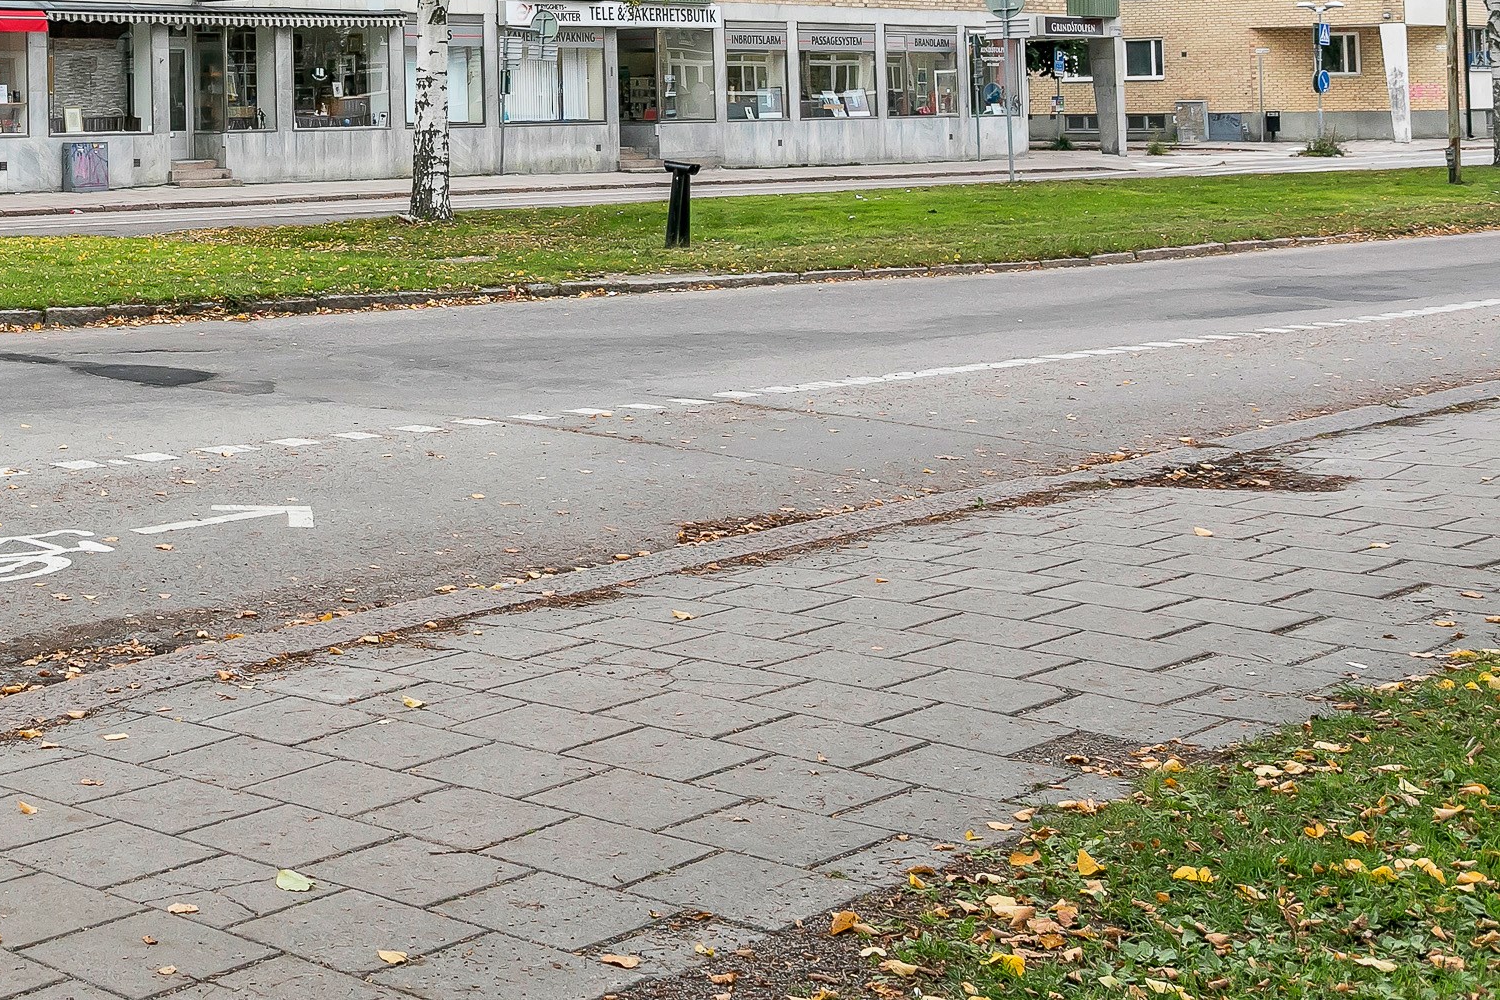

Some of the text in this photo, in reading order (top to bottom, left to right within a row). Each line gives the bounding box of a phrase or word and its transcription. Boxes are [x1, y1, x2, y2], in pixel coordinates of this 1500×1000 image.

[588, 6, 615, 21] TELE
[617, 4, 625, 21] &
[731, 34, 782, 46] INBROTTSLARM
[811, 35, 863, 46] PASSAGESYSTEM
[914, 37, 950, 48] BRANDLARM
[1056, 50, 1063, 61] P
